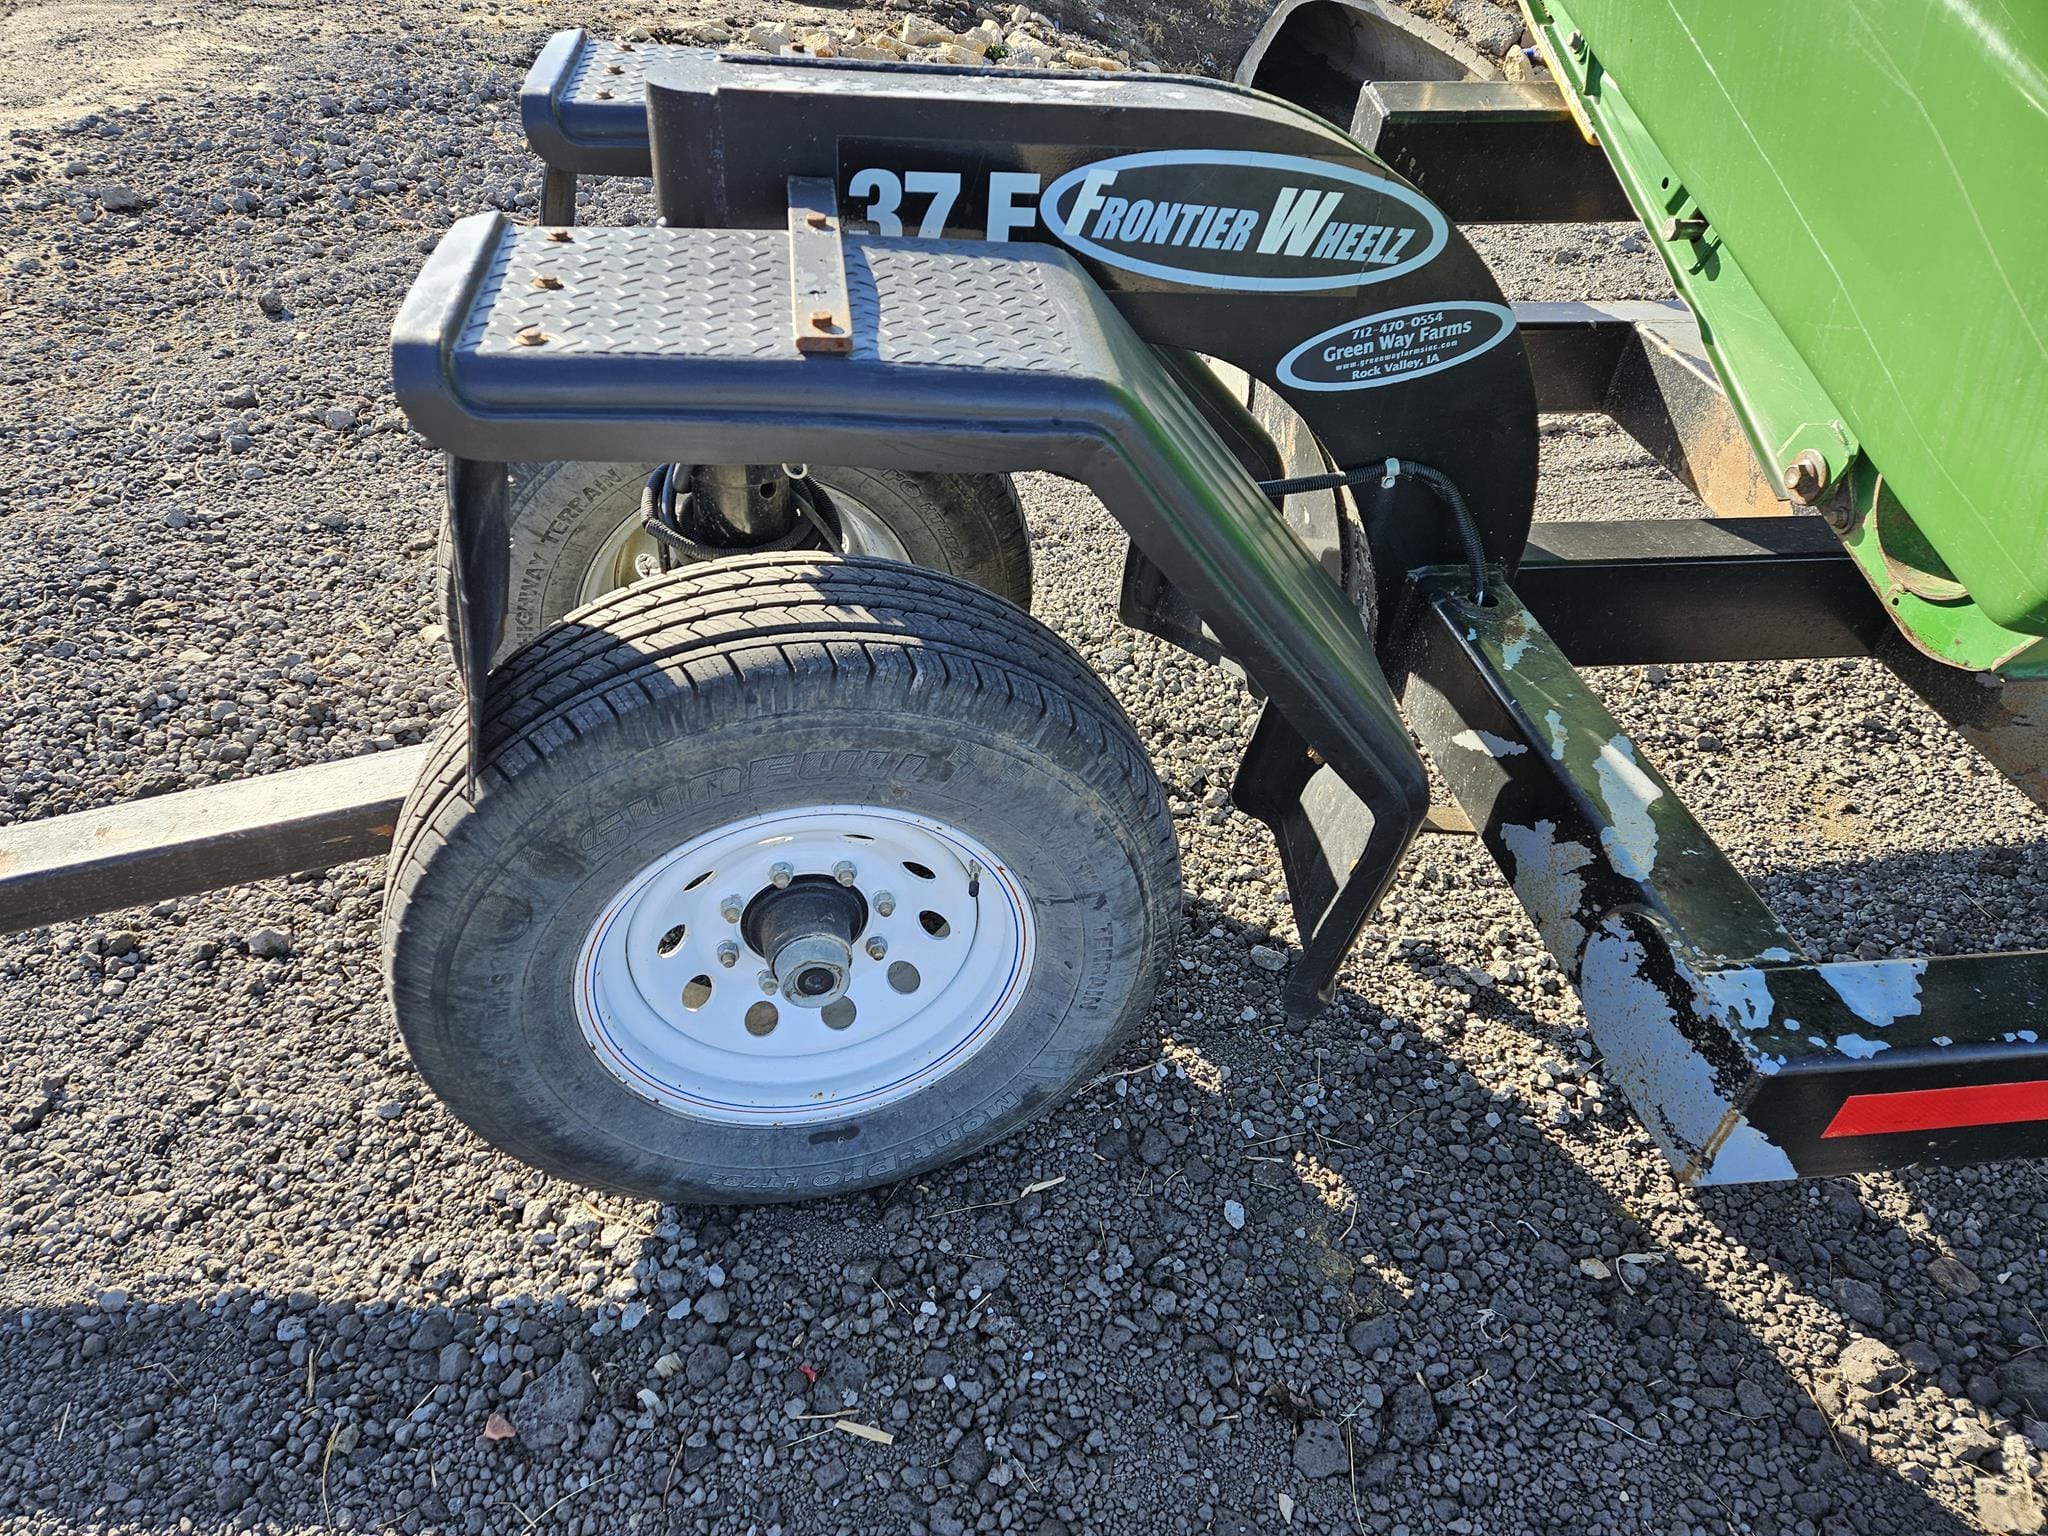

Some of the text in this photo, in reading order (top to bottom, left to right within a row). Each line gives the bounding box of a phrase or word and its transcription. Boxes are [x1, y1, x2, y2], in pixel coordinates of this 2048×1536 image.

[848, 167, 962, 239] 37
[1062, 168, 1417, 265] FRONTIER WHEELZ
[1322, 319, 1473, 363] Green Way Farms
[1351, 310, 1444, 341] 712-470-0554
[1334, 338, 1459, 372] www.greenwayfarmsinc.com
[1351, 353, 1441, 380] Rock Valley, IA
[540, 466, 623, 546] TERRAIN
